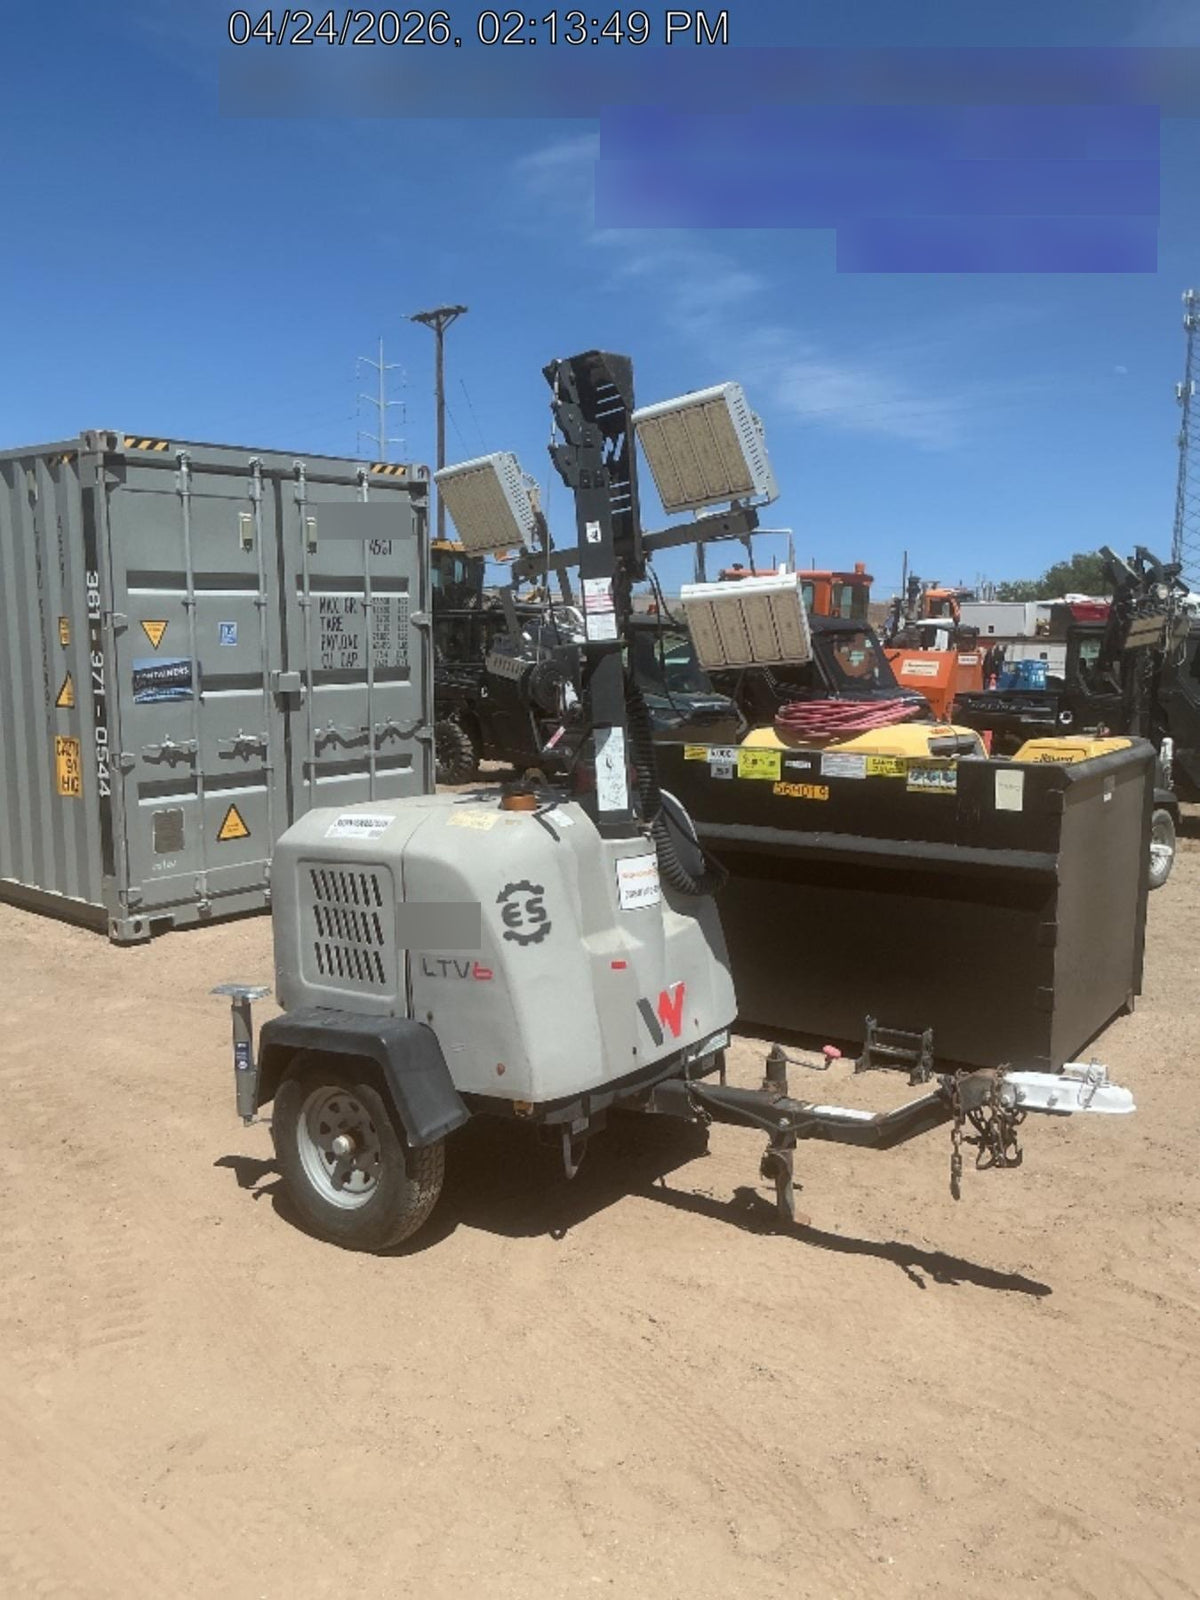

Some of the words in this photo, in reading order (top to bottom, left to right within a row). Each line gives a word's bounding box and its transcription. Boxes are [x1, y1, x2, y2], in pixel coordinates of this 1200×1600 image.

[319, 616, 344, 632] TARE
[501, 896, 547, 928] ES
[422, 957, 493, 981] LTV6
